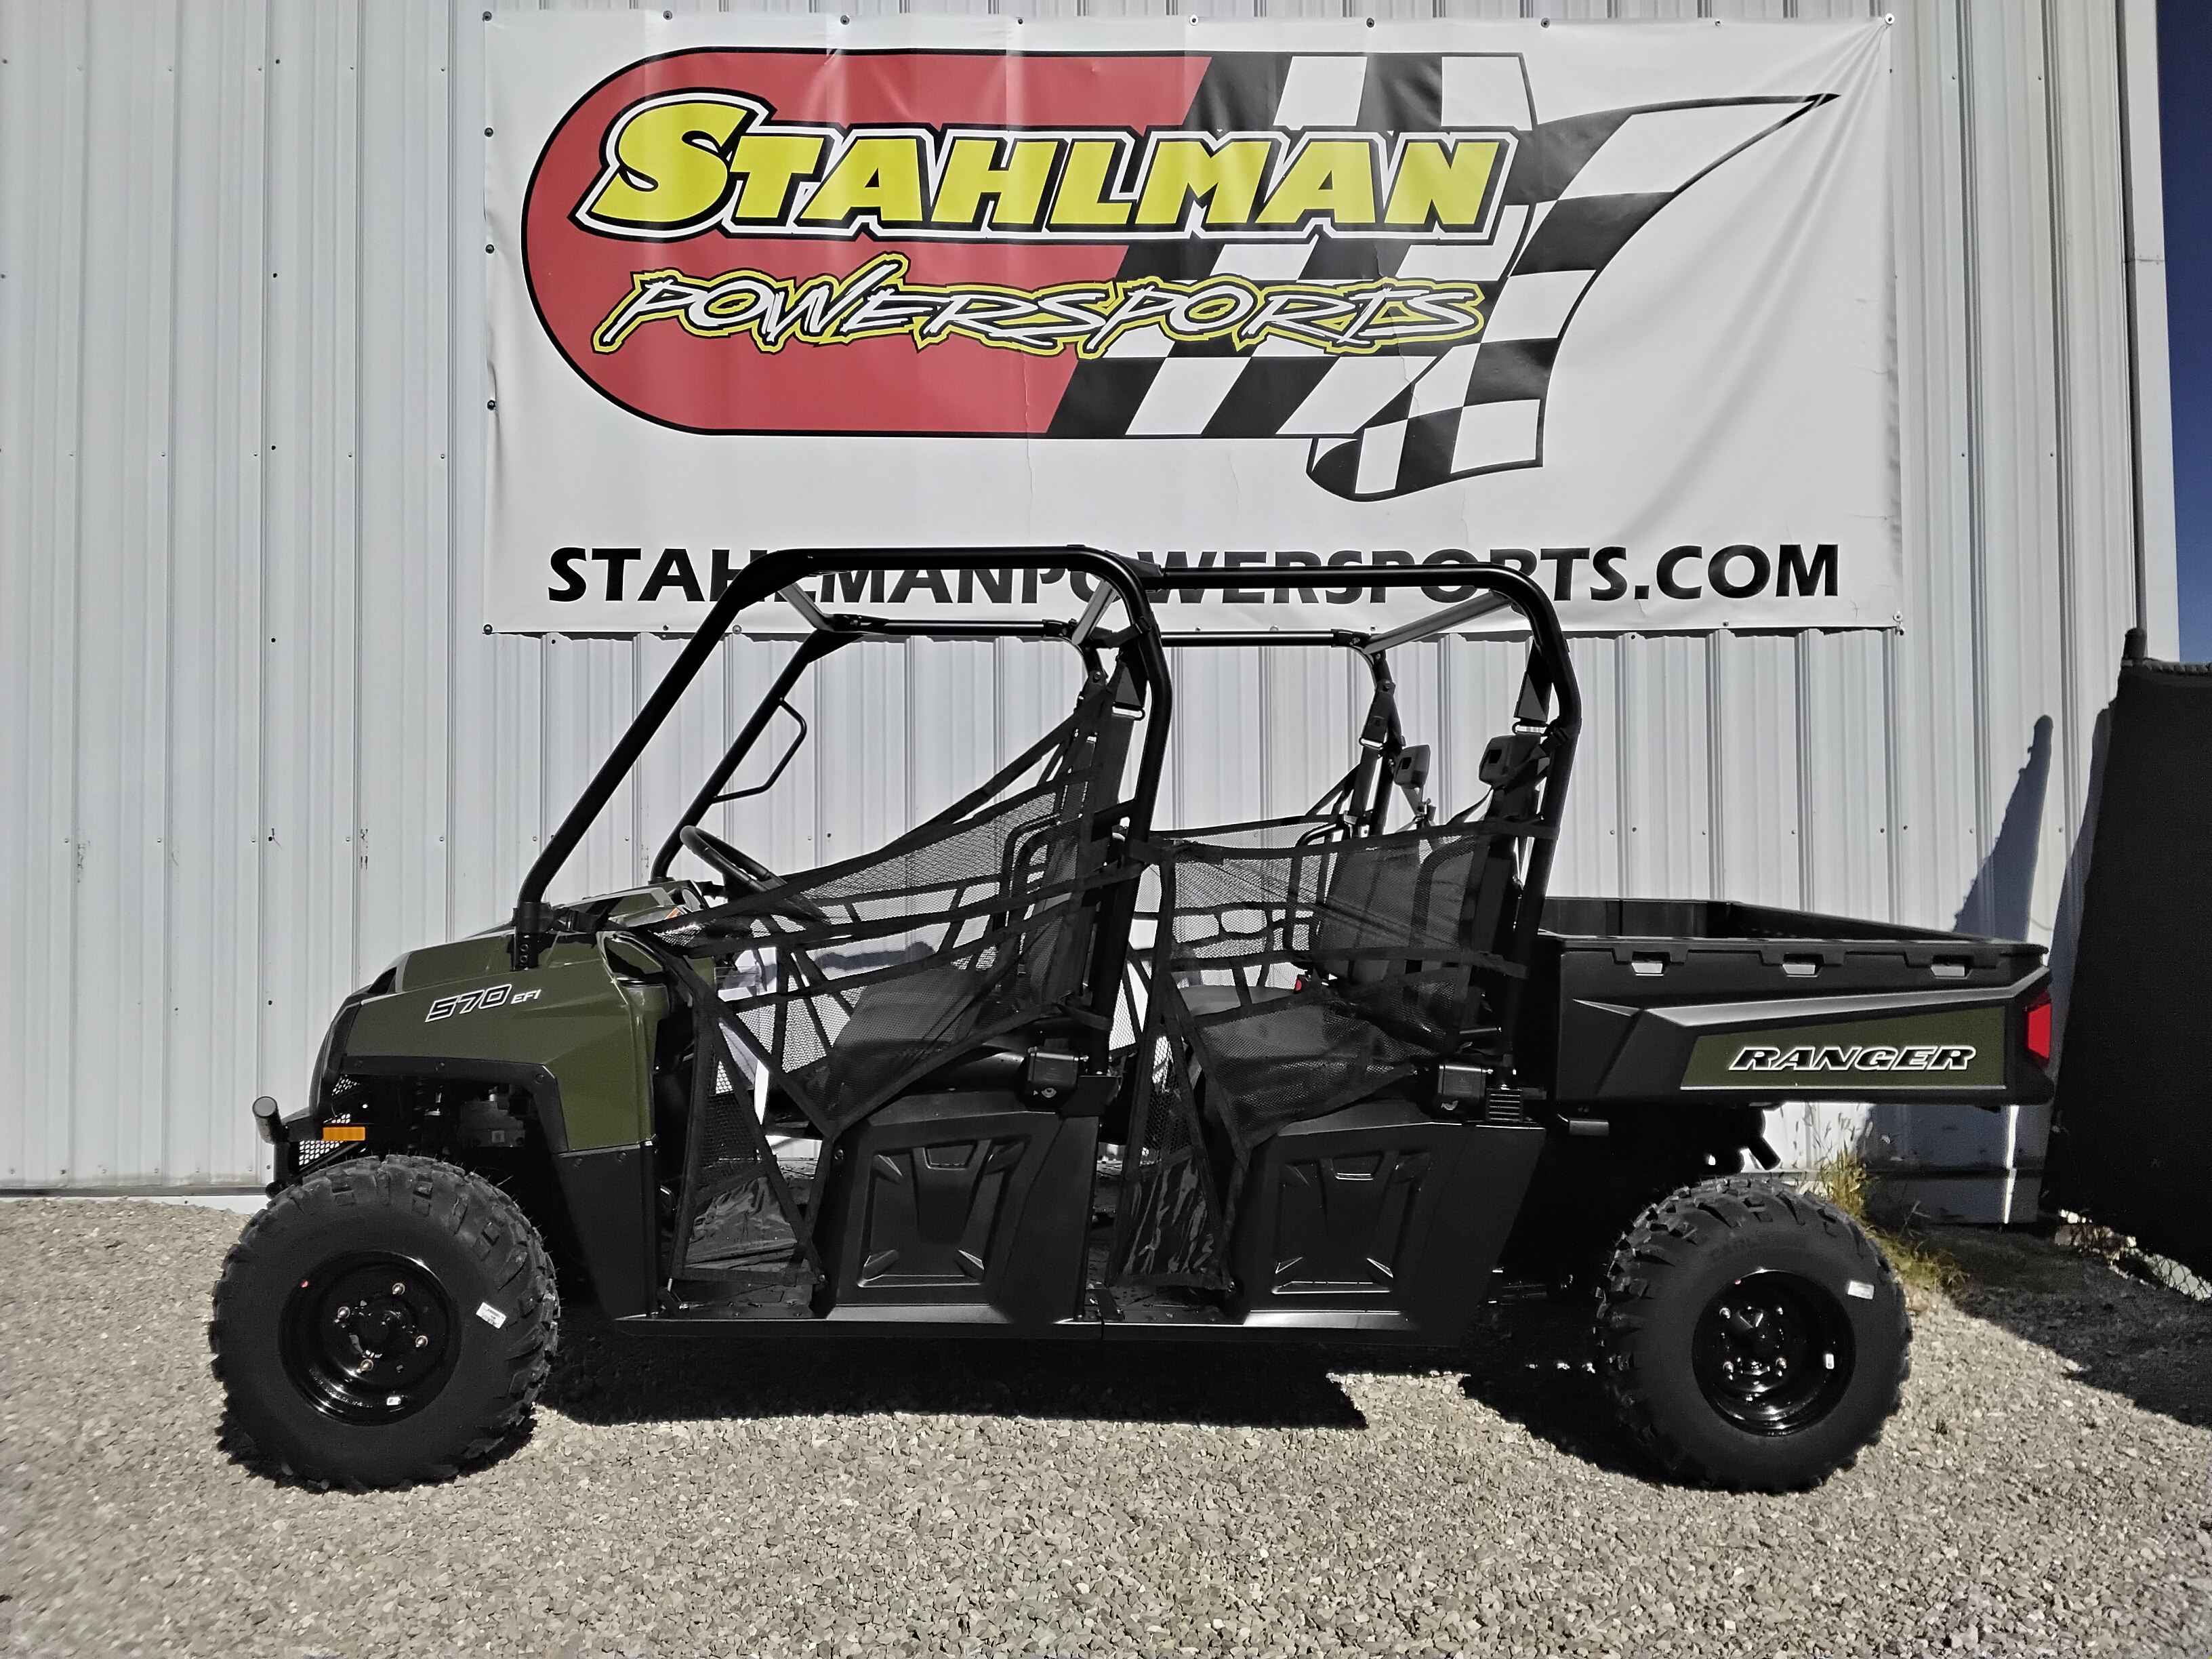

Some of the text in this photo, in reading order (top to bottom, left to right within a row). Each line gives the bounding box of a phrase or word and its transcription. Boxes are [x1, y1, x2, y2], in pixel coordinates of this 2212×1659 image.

[573, 90, 1518, 240] STAHLMAN
[595, 253, 1485, 356] POWERSPORTS
[425, 984, 541, 1022] 570 EFI
[1728, 1046, 1976, 1071] RANGER
